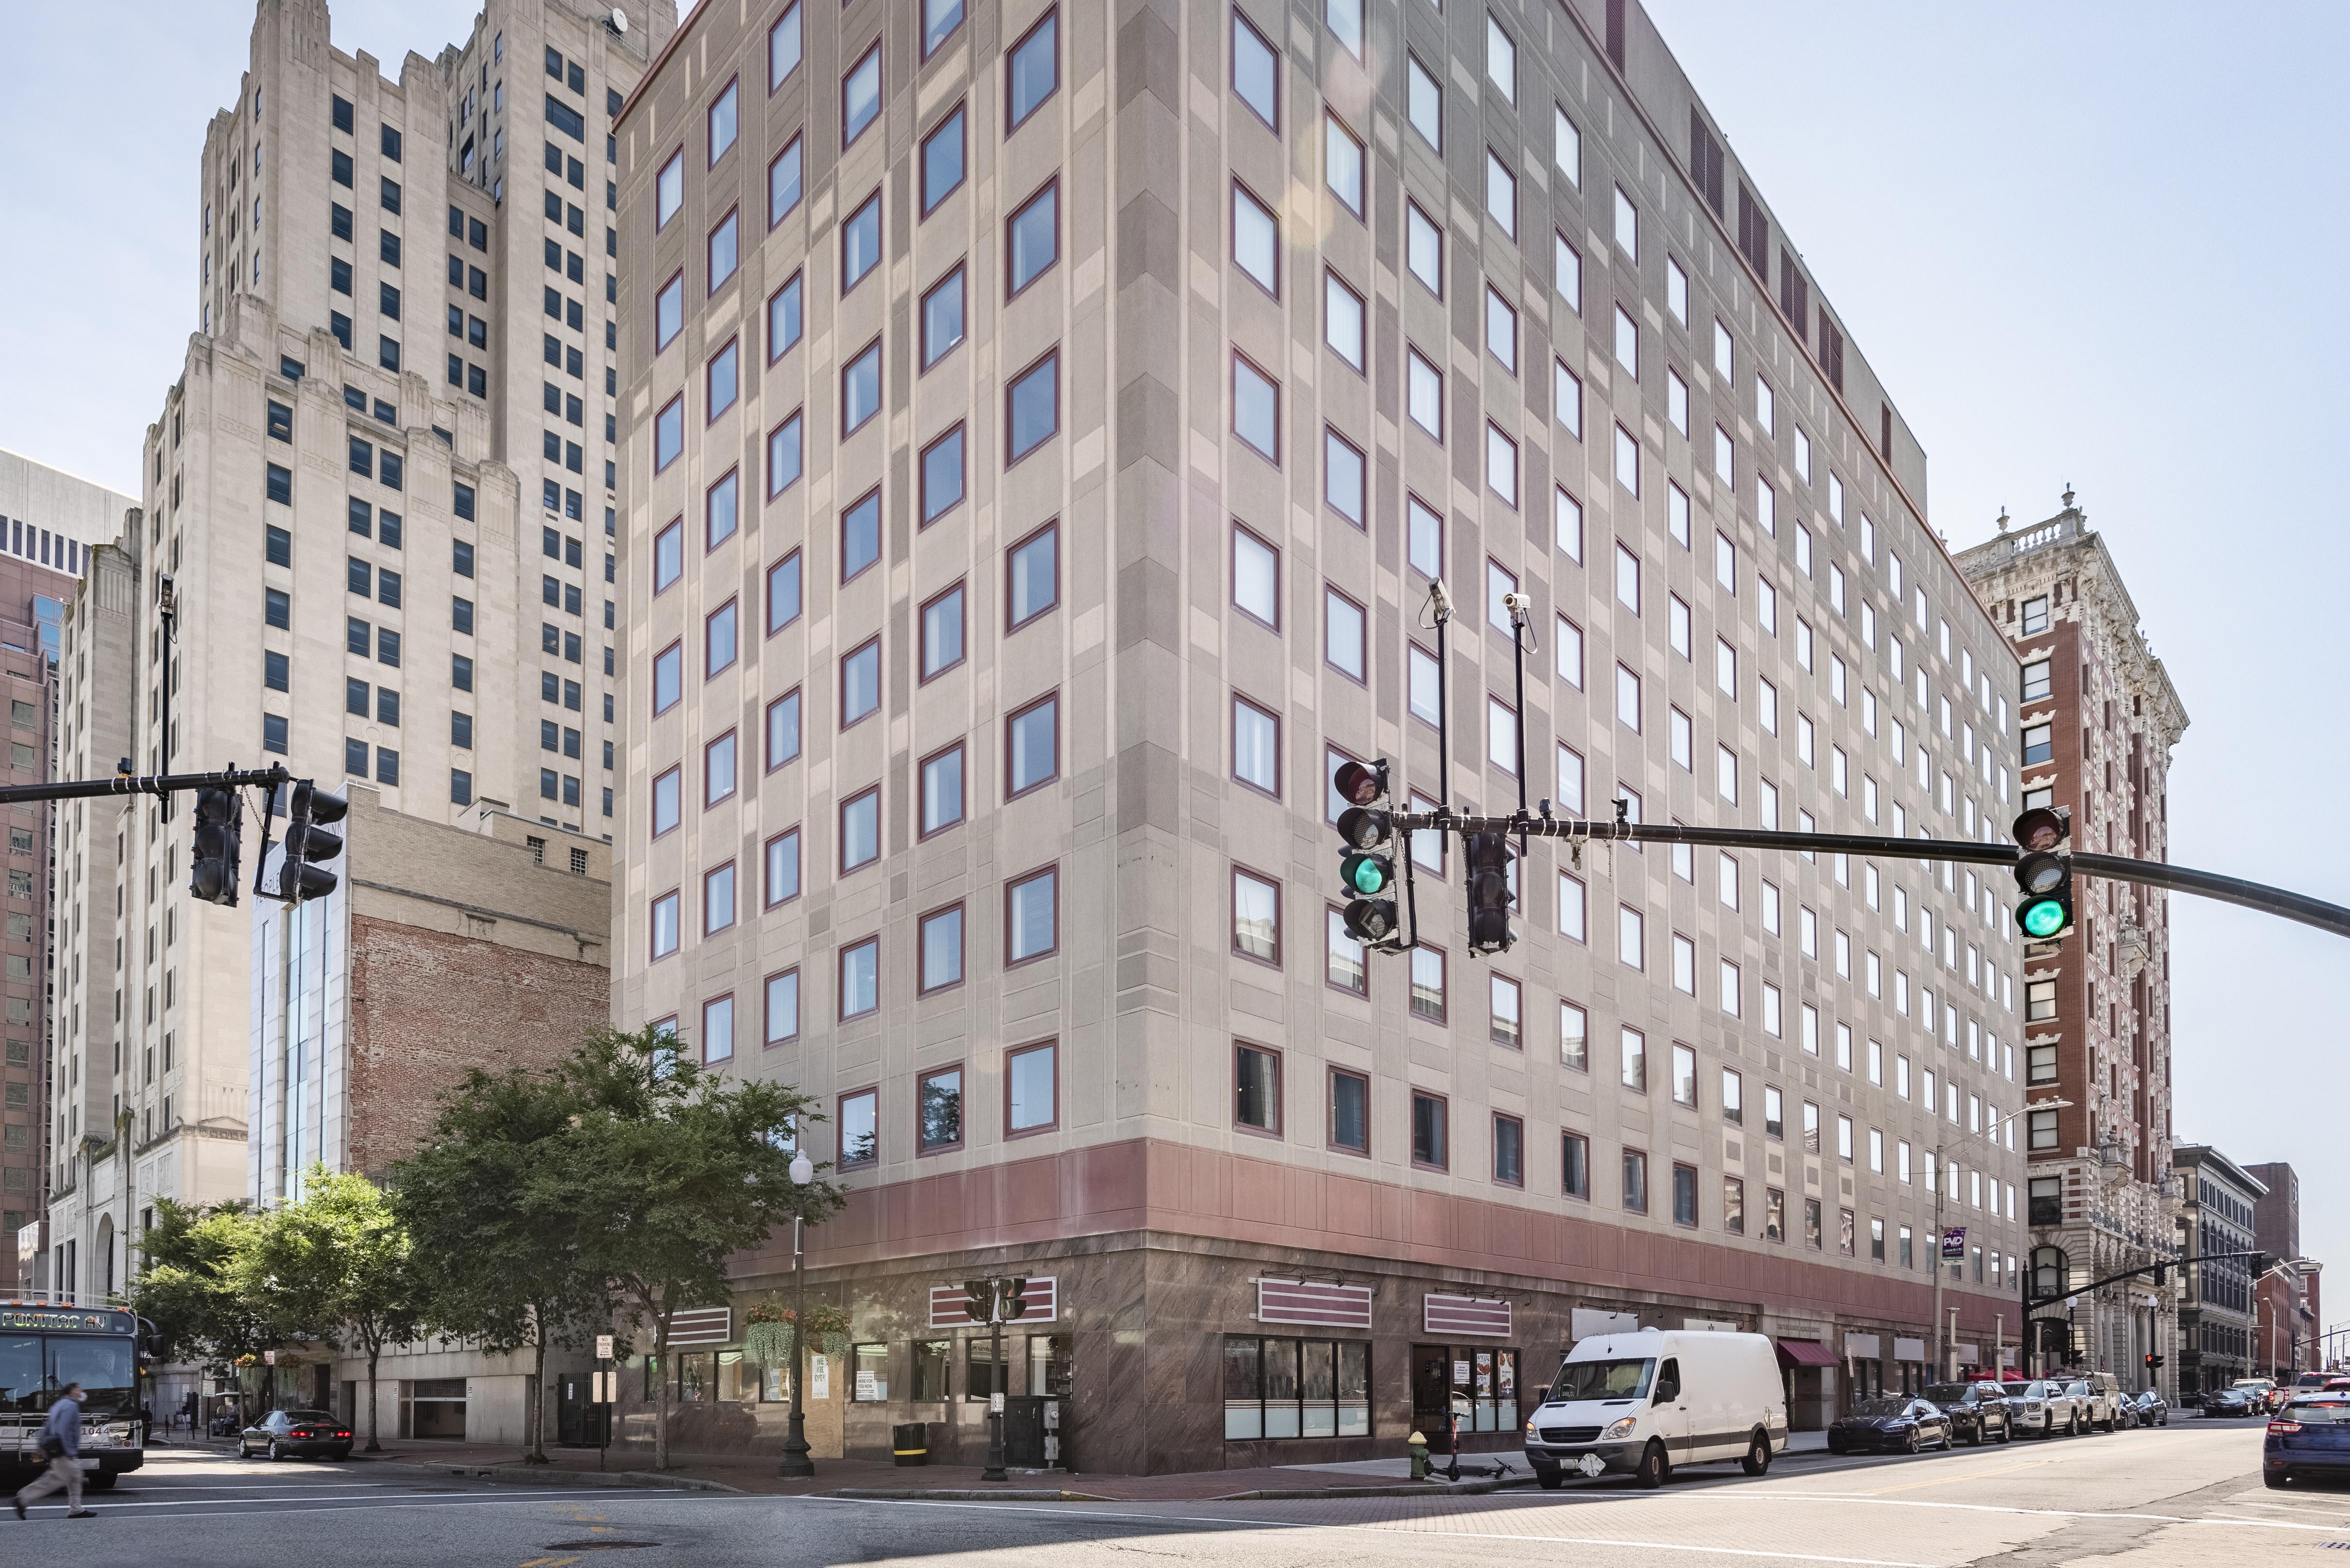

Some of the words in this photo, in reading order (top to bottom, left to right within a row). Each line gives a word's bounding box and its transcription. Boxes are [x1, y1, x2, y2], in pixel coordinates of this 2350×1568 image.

[1944, 1236, 1963, 1246] PVD
[3, 1313, 80, 1328] PONTIAC
[84, 1316, 107, 1329] AV
[82, 1427, 110, 1435] 1044
